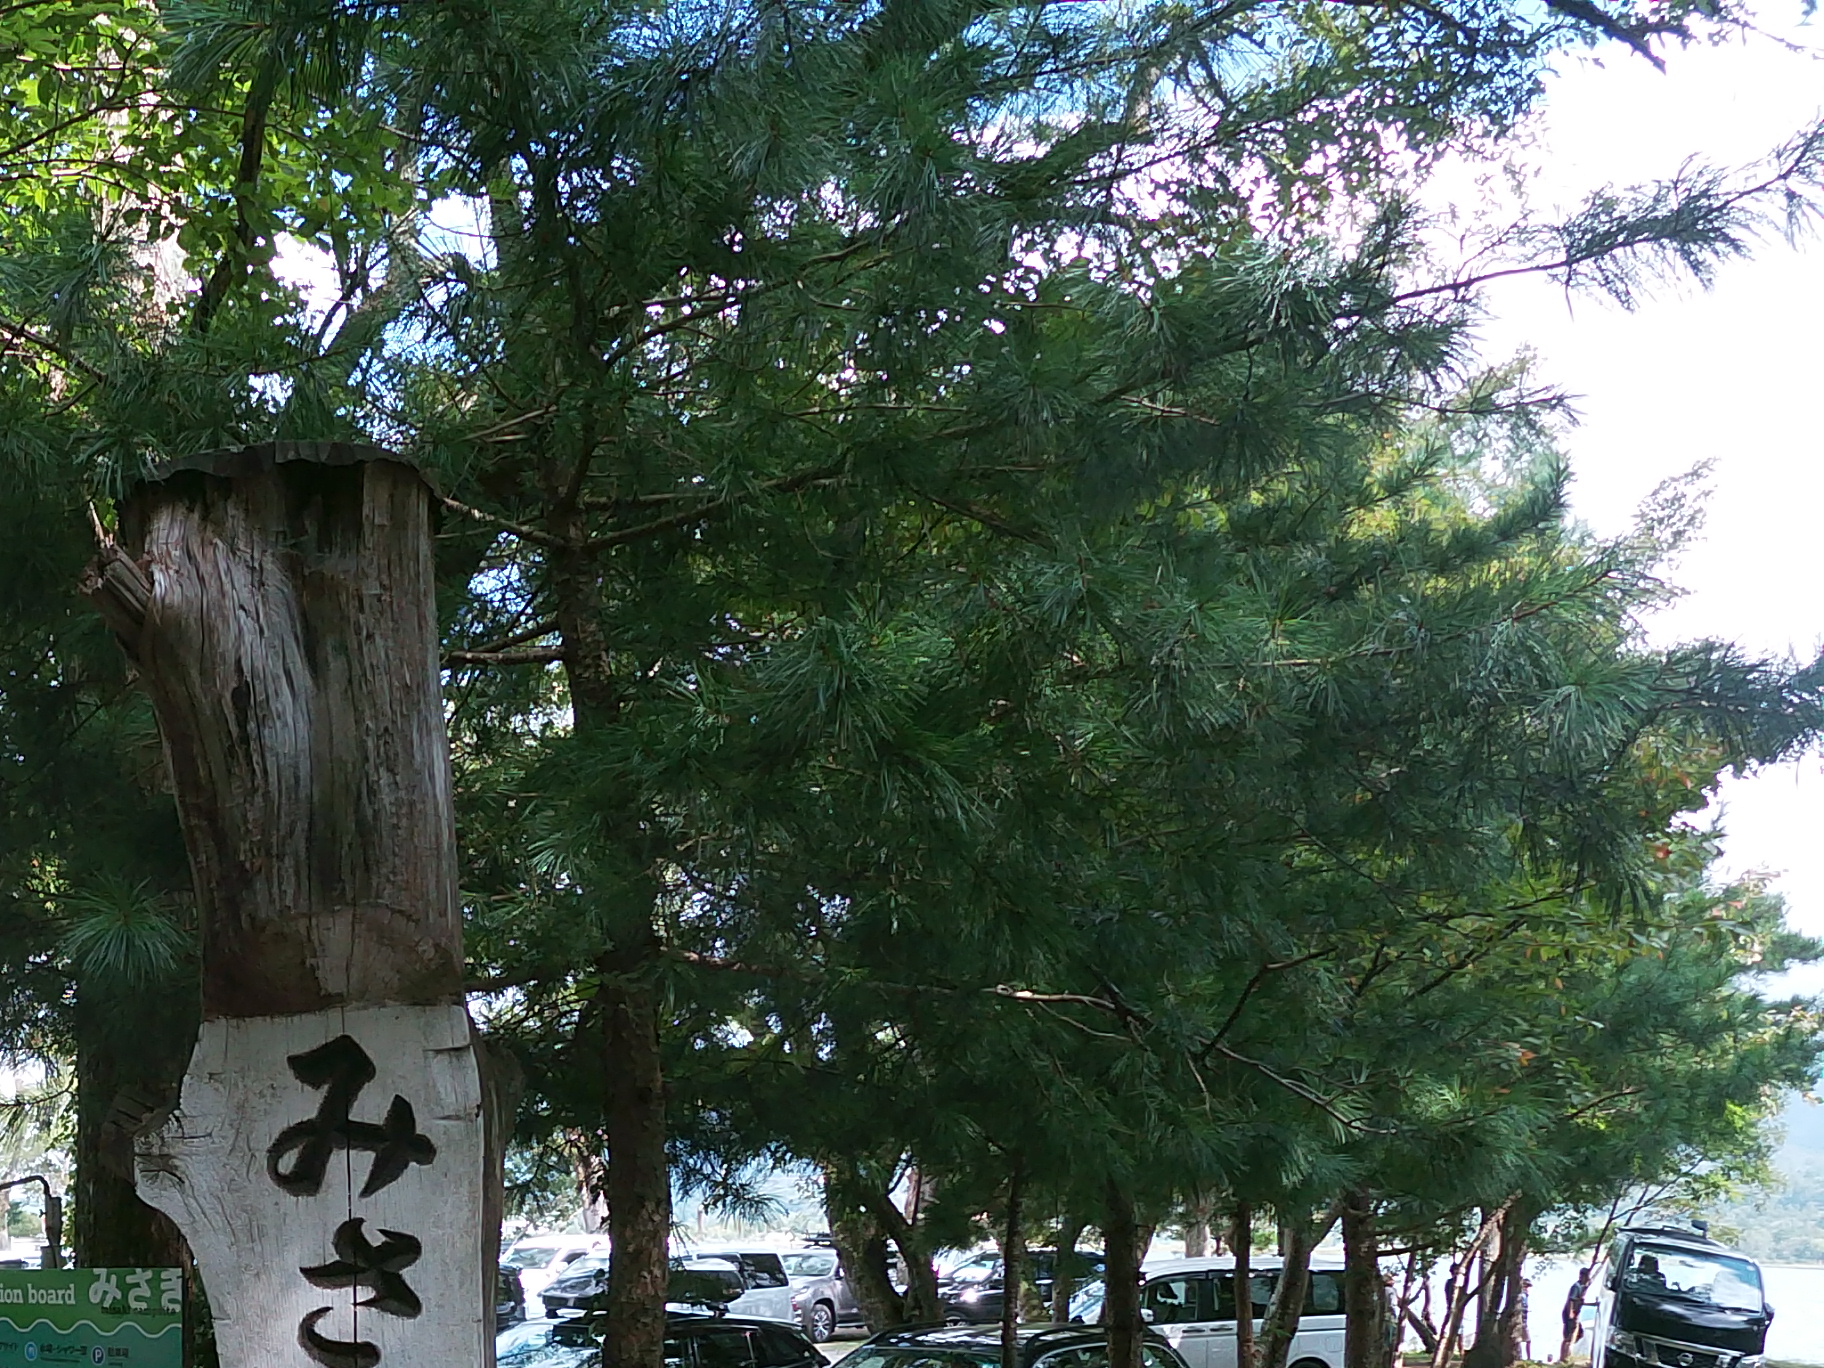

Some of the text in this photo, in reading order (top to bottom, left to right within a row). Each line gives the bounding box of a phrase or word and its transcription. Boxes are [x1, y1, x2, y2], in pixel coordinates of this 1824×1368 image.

[27, 1283, 75, 1305] board
[89, 1267, 182, 1313] みさき
